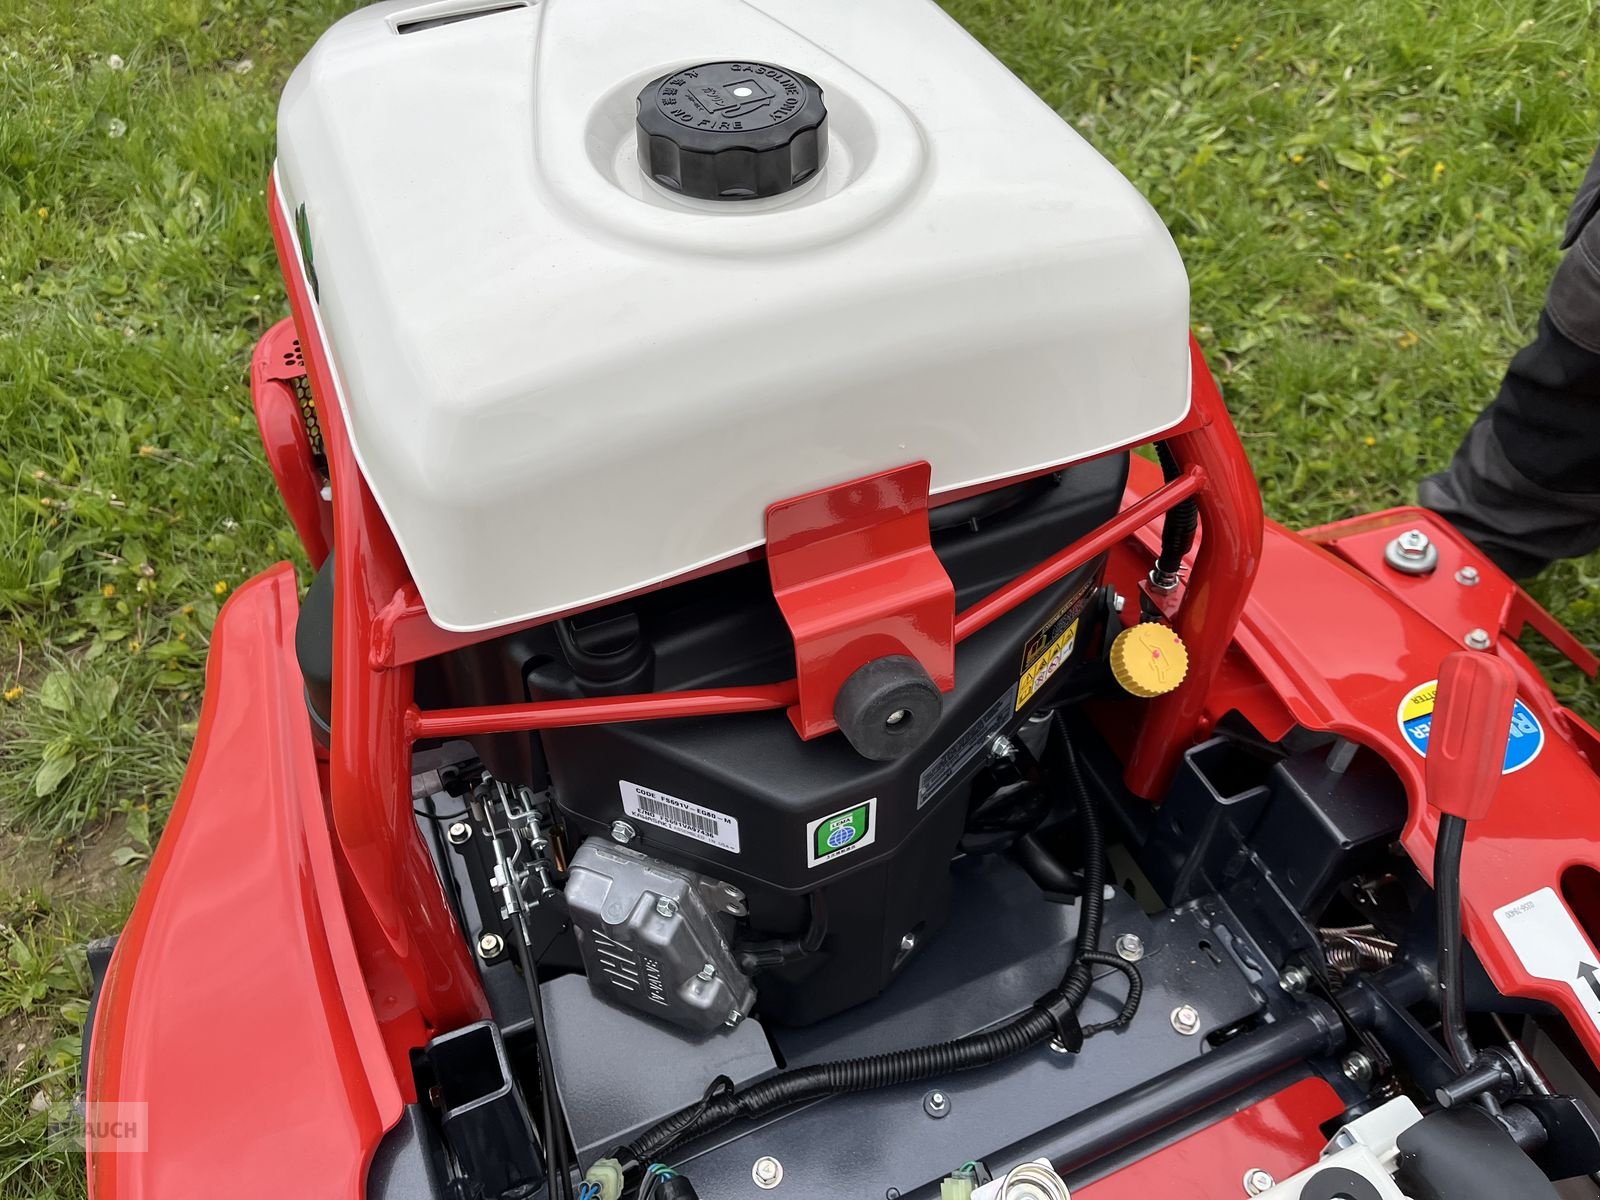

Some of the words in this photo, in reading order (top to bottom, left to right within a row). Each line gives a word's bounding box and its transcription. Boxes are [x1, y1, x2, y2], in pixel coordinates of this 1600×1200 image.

[702, 87, 726, 107] ガソリン
[730, 64, 799, 96] GASOLINE
[769, 98, 799, 122] ONLY
[670, 108, 694, 122] NO
[697, 119, 744, 130] FIRE
[635, 787, 656, 799] CODE
[631, 811, 673, 829] KAWASAKI
[831, 817, 851, 828] LEMA
